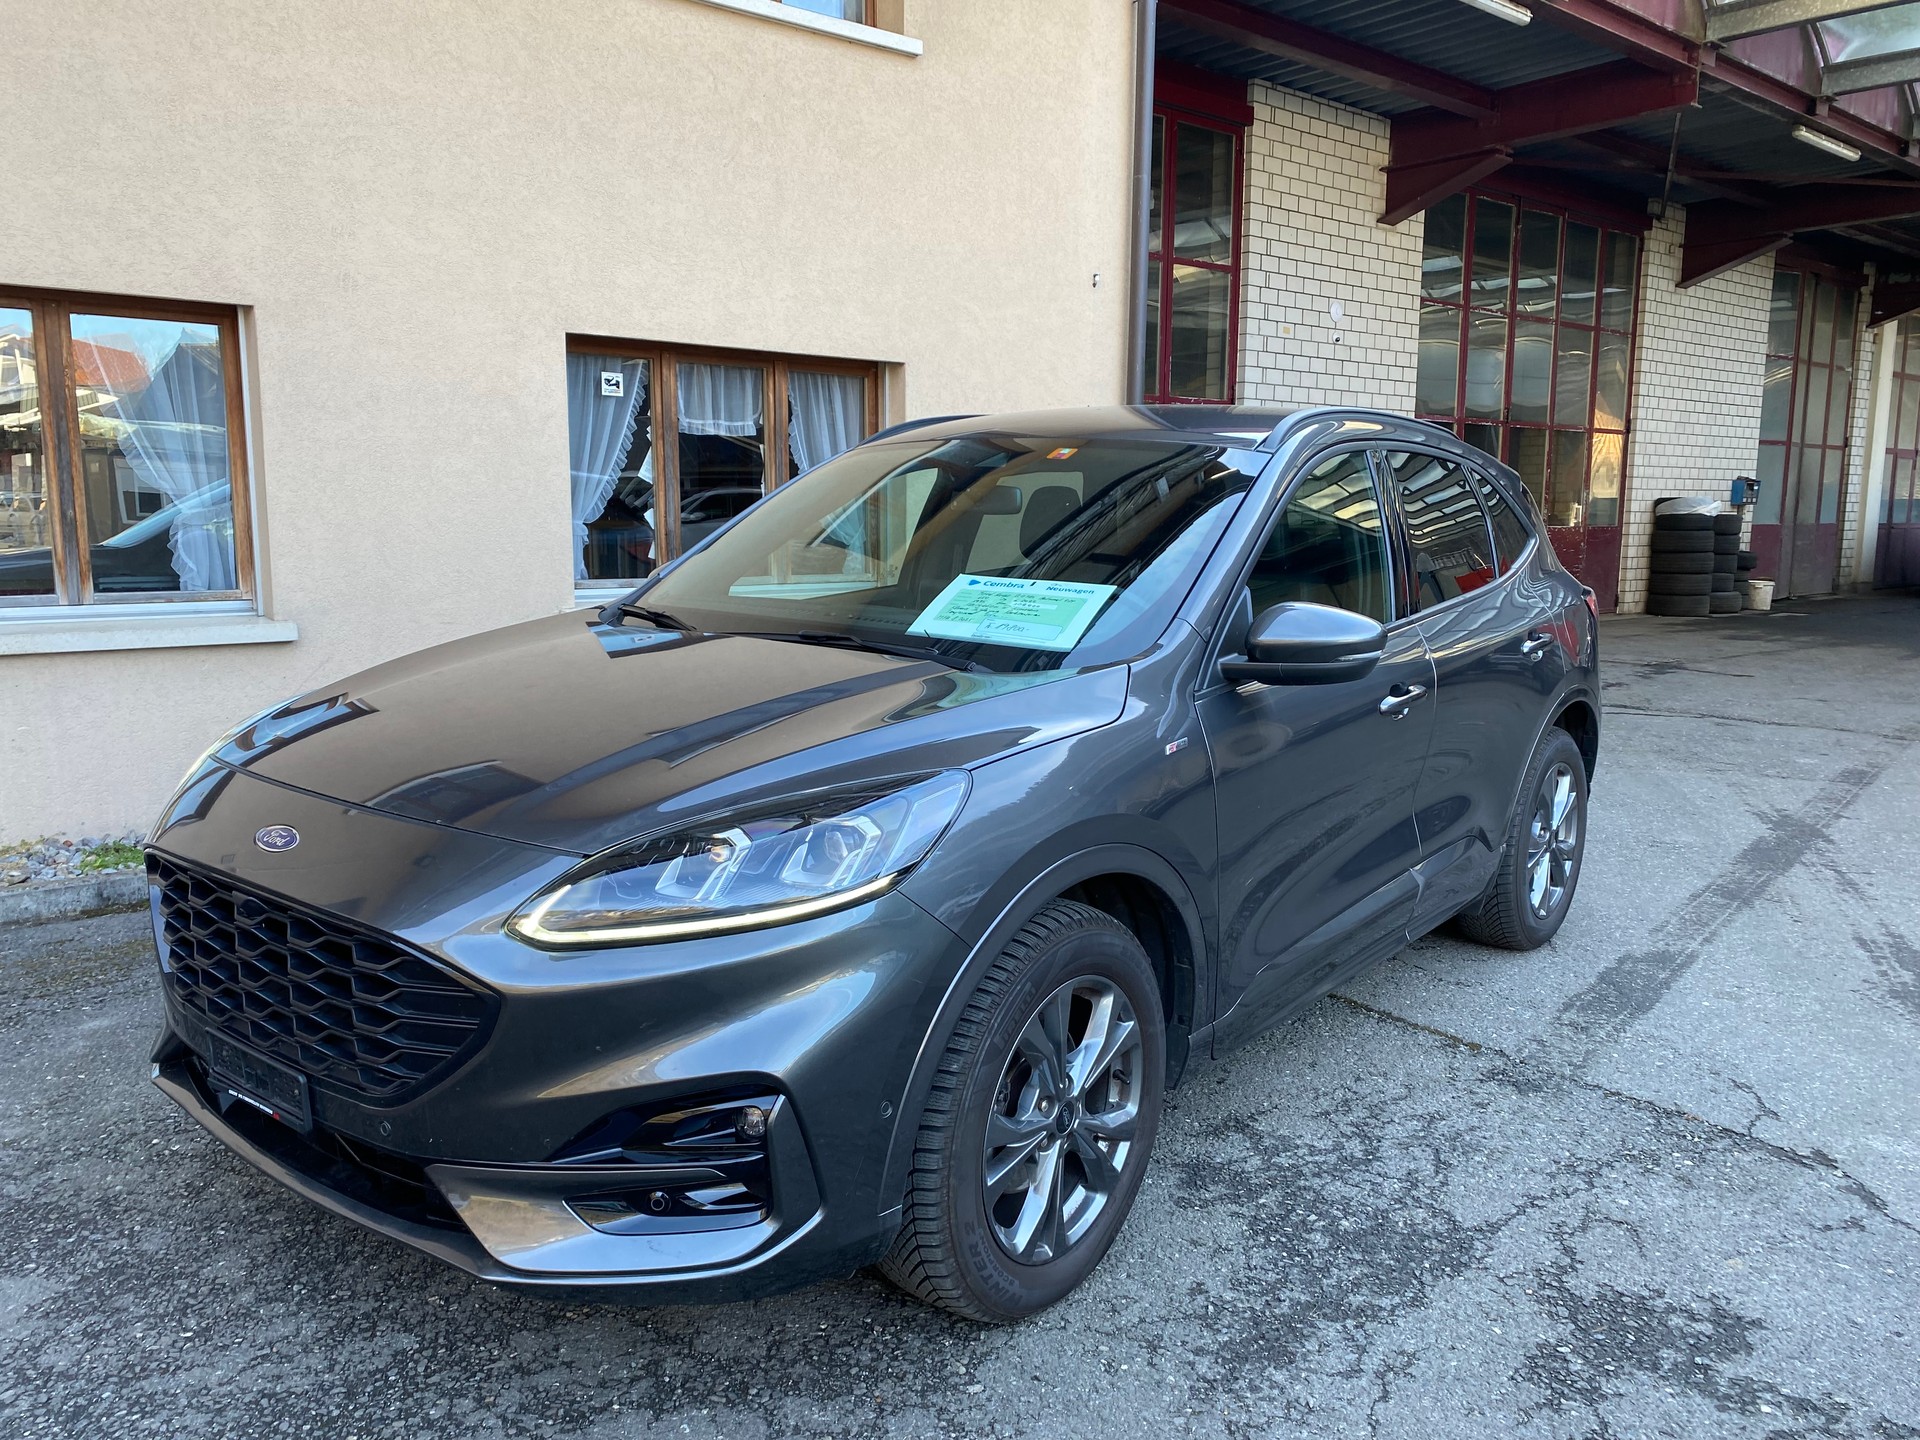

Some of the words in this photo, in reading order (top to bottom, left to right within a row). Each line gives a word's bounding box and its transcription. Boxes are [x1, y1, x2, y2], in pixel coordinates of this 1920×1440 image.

[983, 580, 1025, 589] Cembra
[1045, 585, 1095, 595] Neuwagen
[968, 1242, 1023, 1306] WINTER
[979, 1235, 1016, 1287] SCORPION
